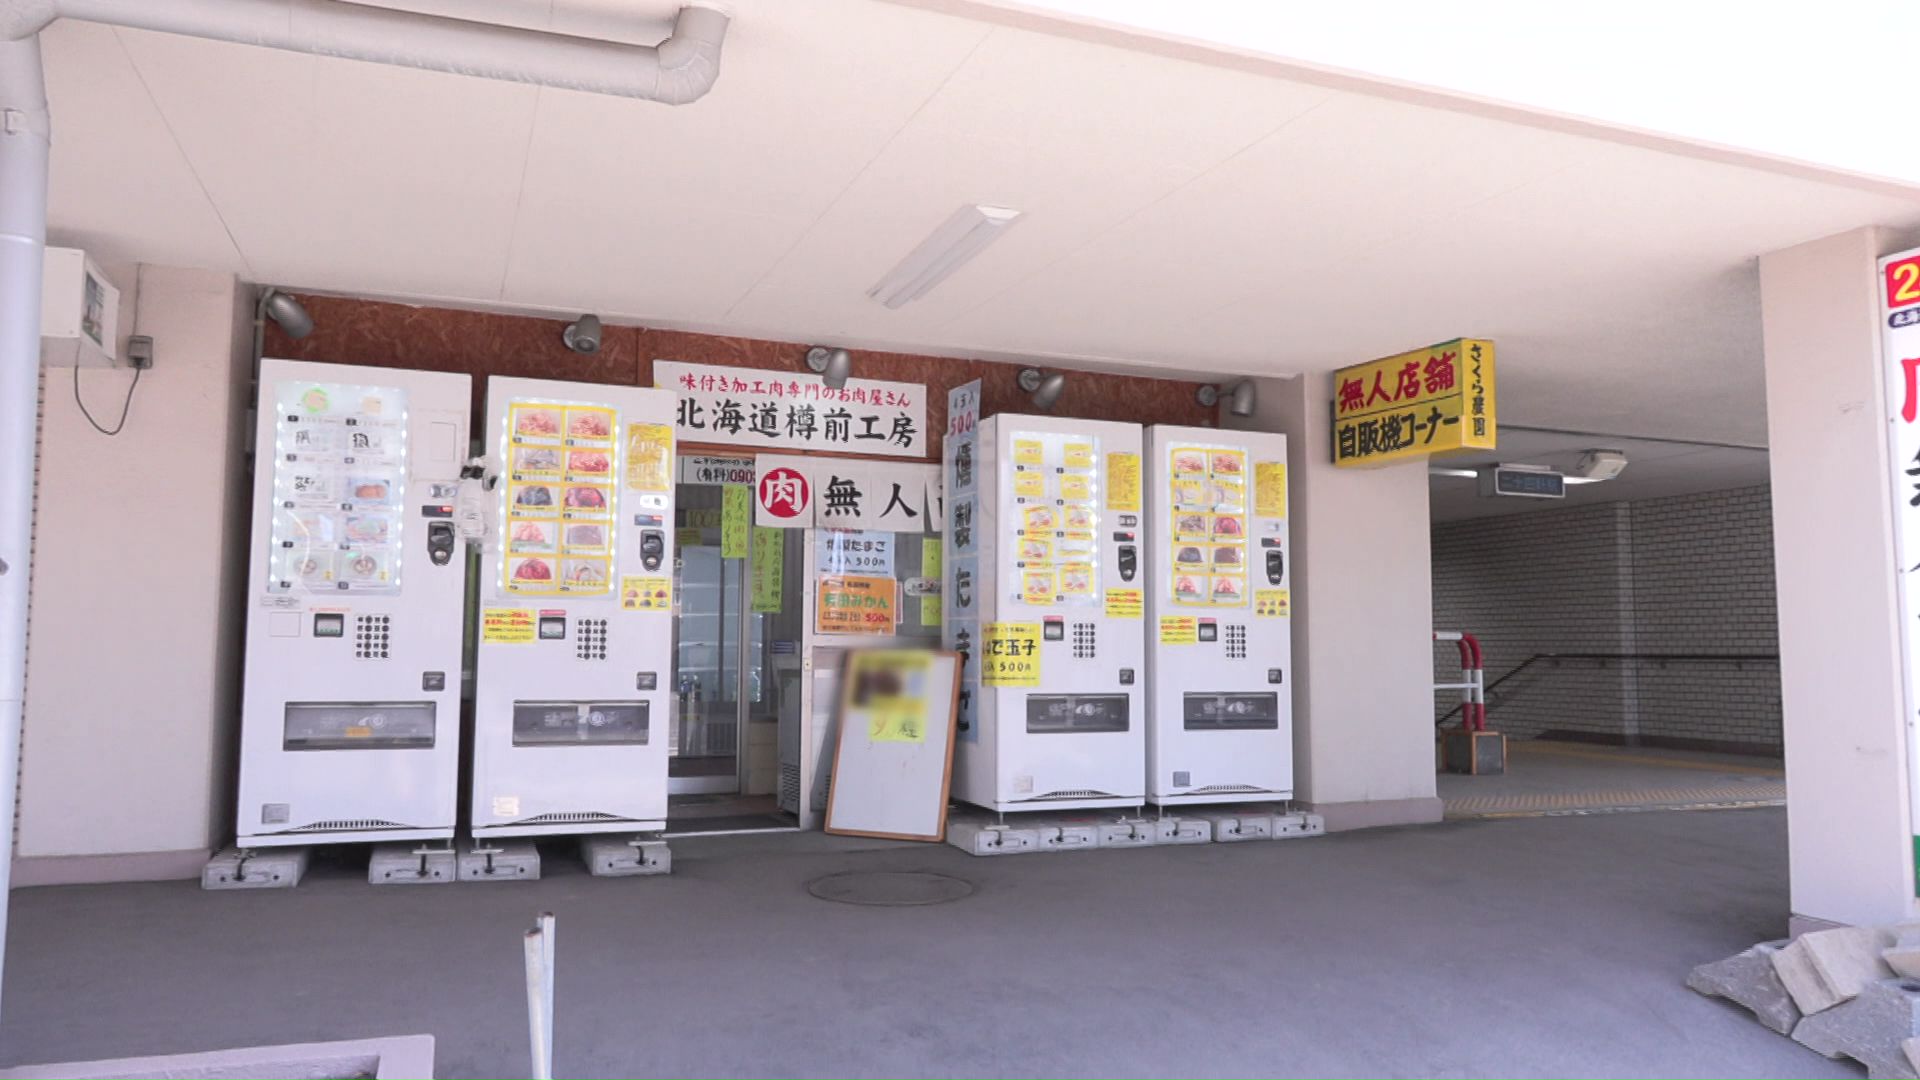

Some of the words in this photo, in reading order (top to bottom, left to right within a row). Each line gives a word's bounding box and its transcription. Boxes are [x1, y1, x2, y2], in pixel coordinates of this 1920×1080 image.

[680, 373, 911, 407] 味付き加工肉専門のお肉屋さん
[1338, 352, 1456, 413] 無人店舗
[1471, 344, 1485, 436] さくら農園
[677, 397, 917, 448] 北海道樽前工房
[1338, 406, 1459, 458] 自販機コーナー
[763, 470, 803, 513] 肉
[823, 475, 943, 518] 無人
